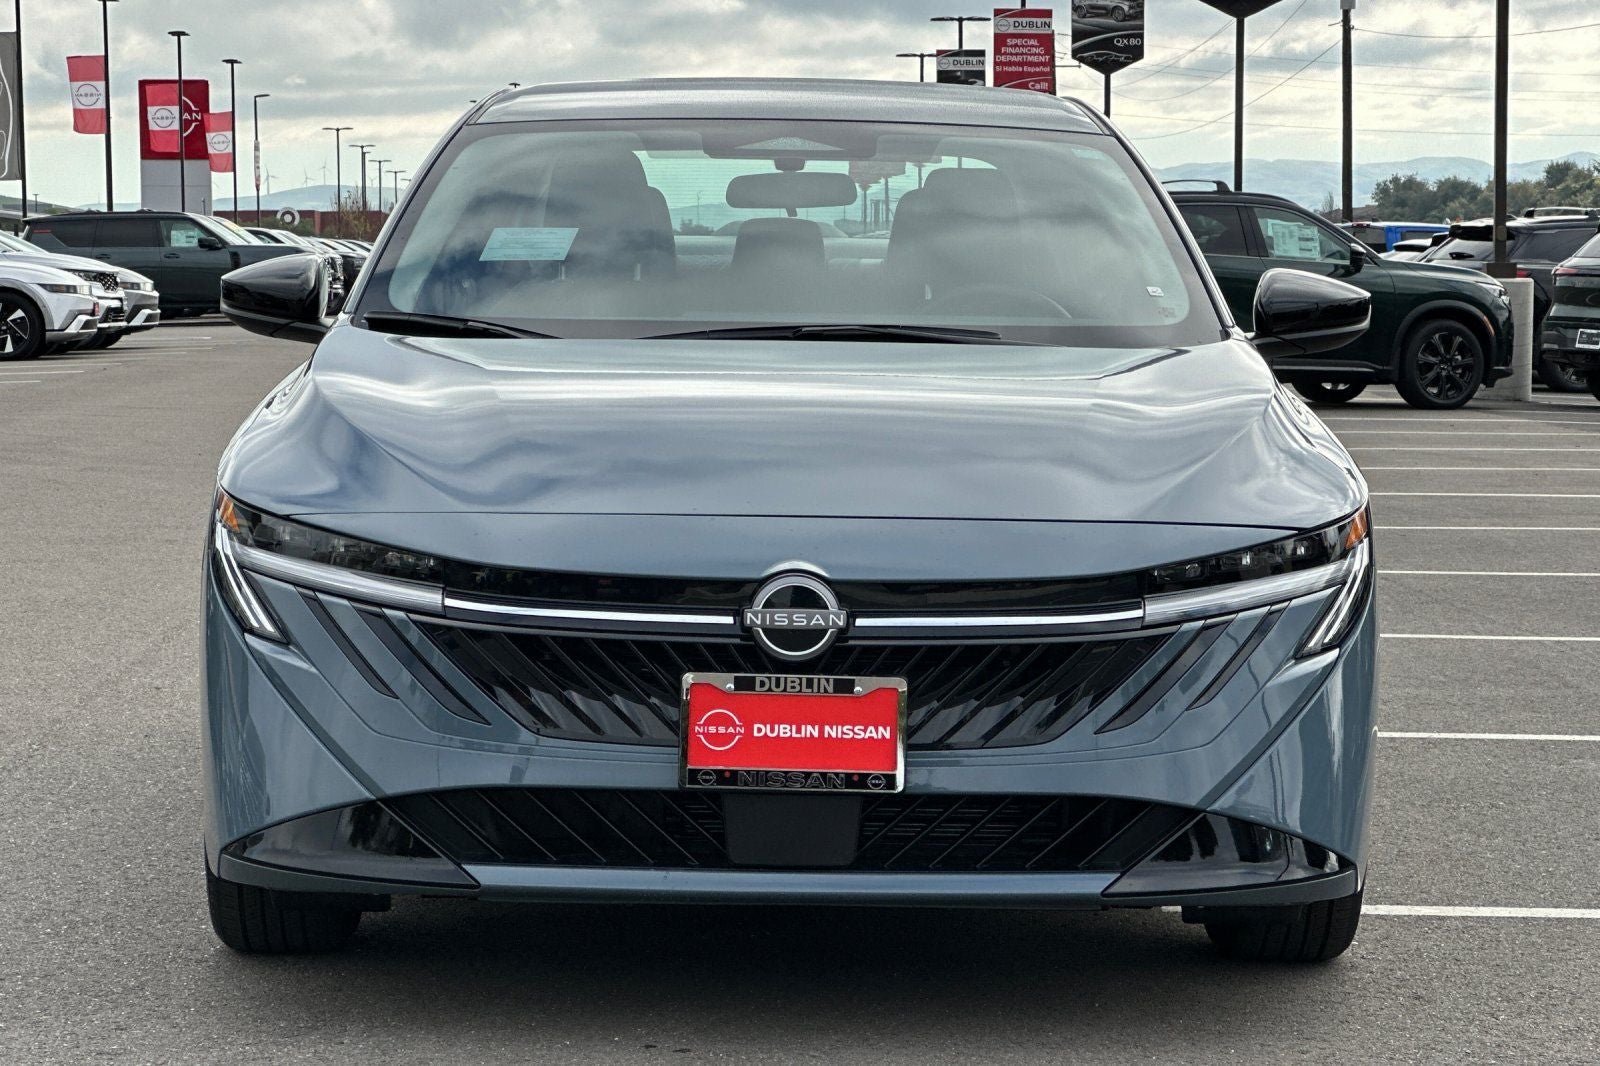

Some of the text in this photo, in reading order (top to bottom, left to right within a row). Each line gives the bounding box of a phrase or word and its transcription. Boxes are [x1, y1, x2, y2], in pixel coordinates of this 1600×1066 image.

[1013, 20, 1051, 29] DUBLIN
[1006, 38, 1039, 46] SPECIAL
[1114, 38, 1142, 46] QX80
[1024, 65, 1050, 73] Español
[746, 612, 845, 627] NISSAN
[755, 676, 834, 694] DUBLIN
[695, 726, 745, 734] NISSAN
[753, 724, 891, 739] DUBLIN NISSAN
[737, 770, 845, 789] NISSAN
